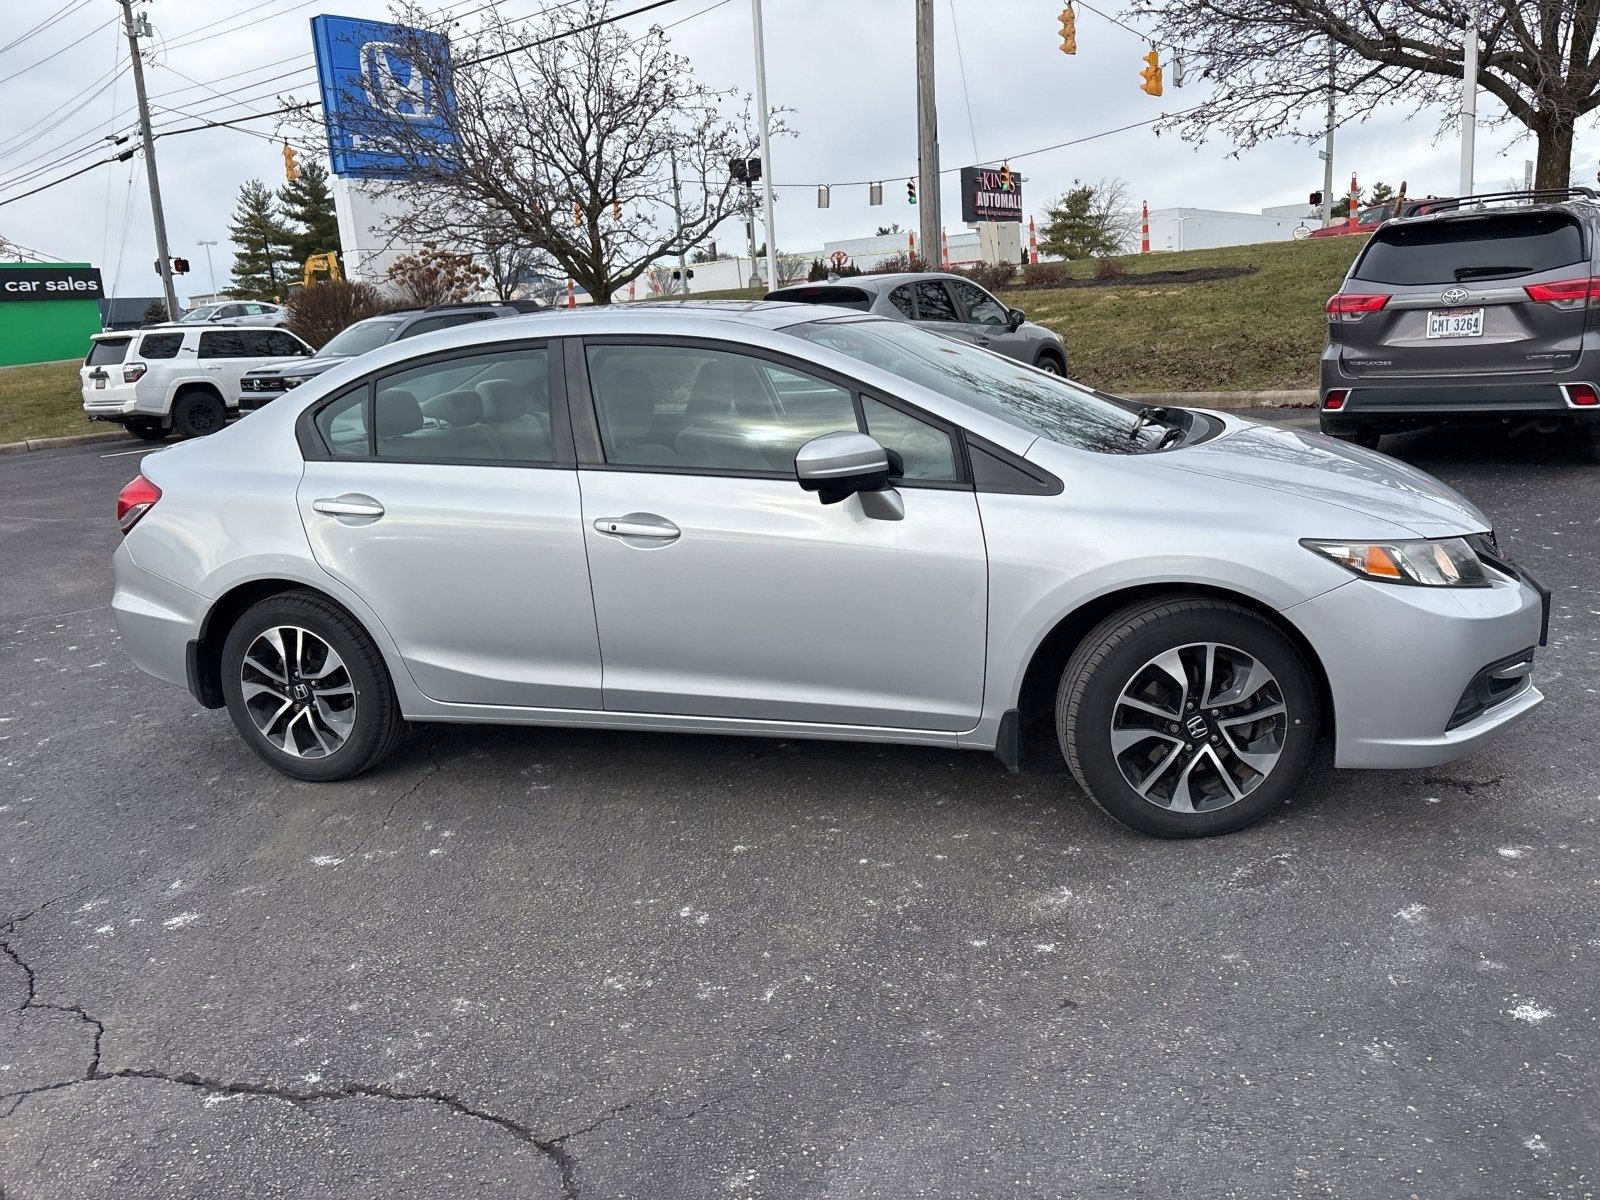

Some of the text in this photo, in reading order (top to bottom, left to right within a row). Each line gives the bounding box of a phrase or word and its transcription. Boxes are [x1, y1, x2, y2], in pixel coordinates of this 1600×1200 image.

[982, 171, 1016, 193] KINS
[976, 191, 1022, 209] AUTOMALL
[4, 276, 99, 292] car sales
[1454, 317, 1479, 331] 3264
